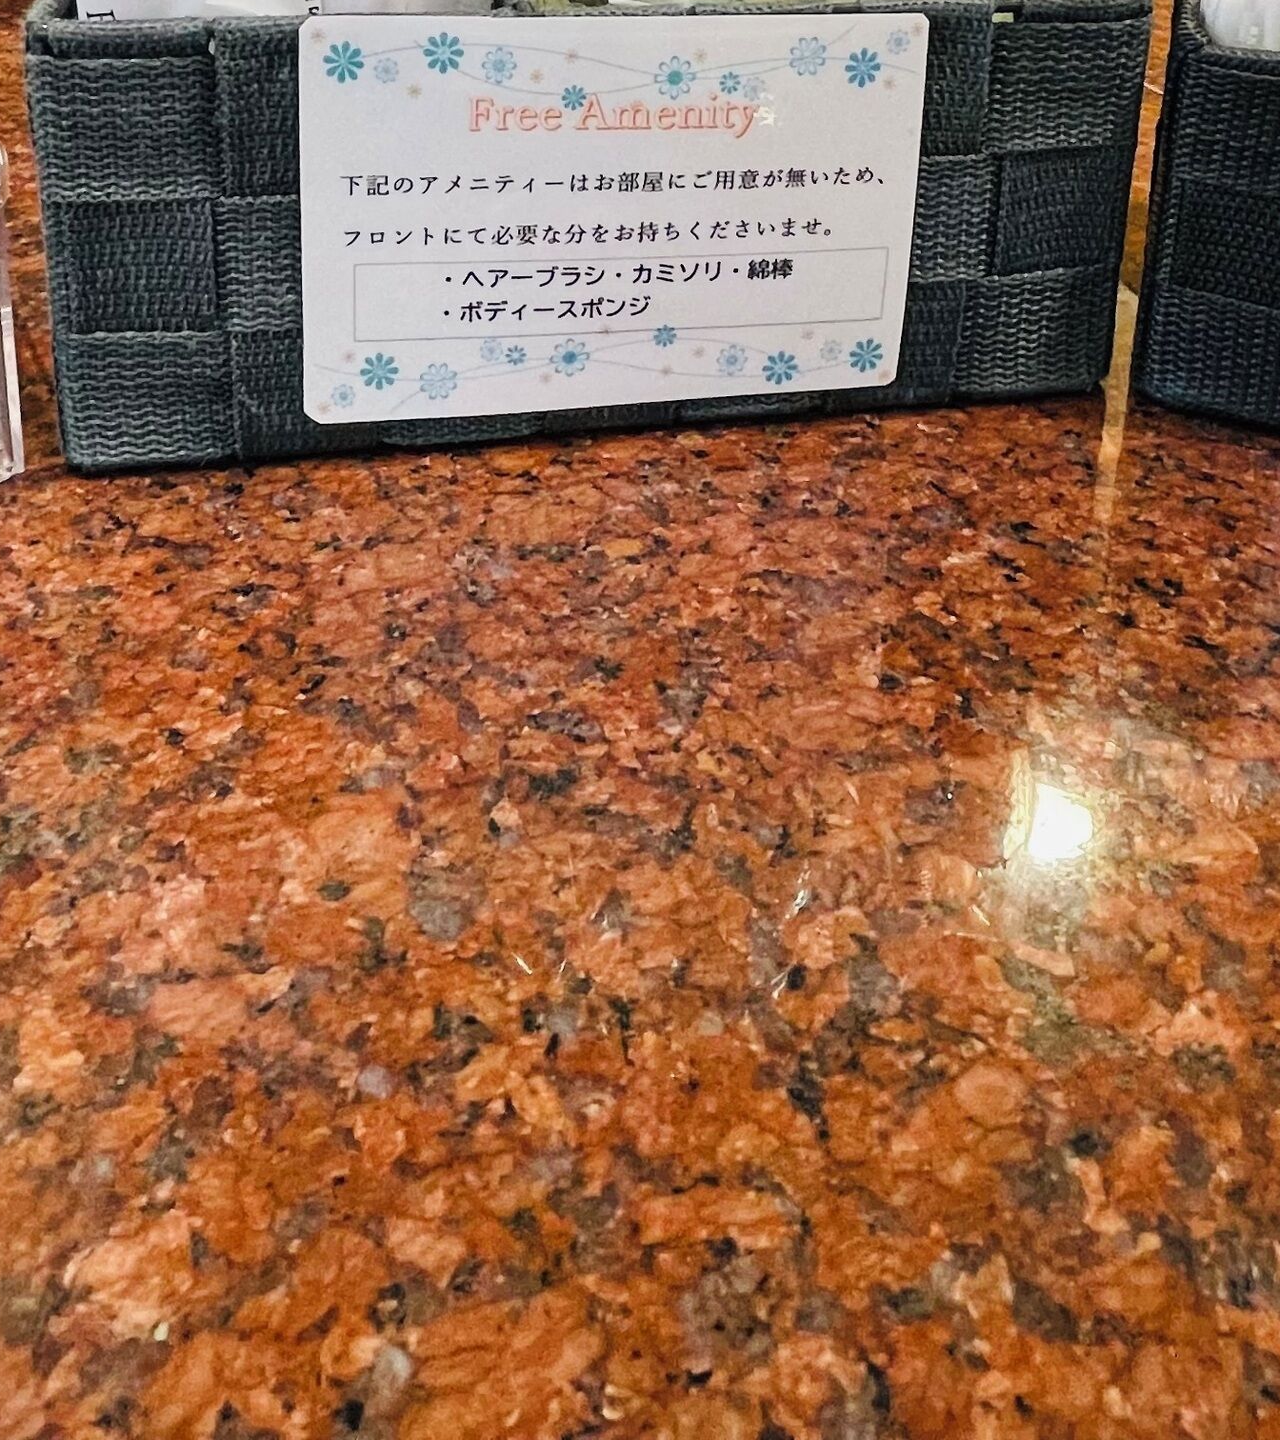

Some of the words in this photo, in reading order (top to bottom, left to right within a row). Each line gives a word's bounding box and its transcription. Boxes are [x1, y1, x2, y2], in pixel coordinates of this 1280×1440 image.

[469, 95, 564, 132] Free
[576, 92, 760, 139] Amenity
[340, 166, 889, 197] 下記のアメニティーはお部屋にご用意が無いため、
[343, 217, 835, 247] フロントにて必要な分をお持ちくださいませ。
